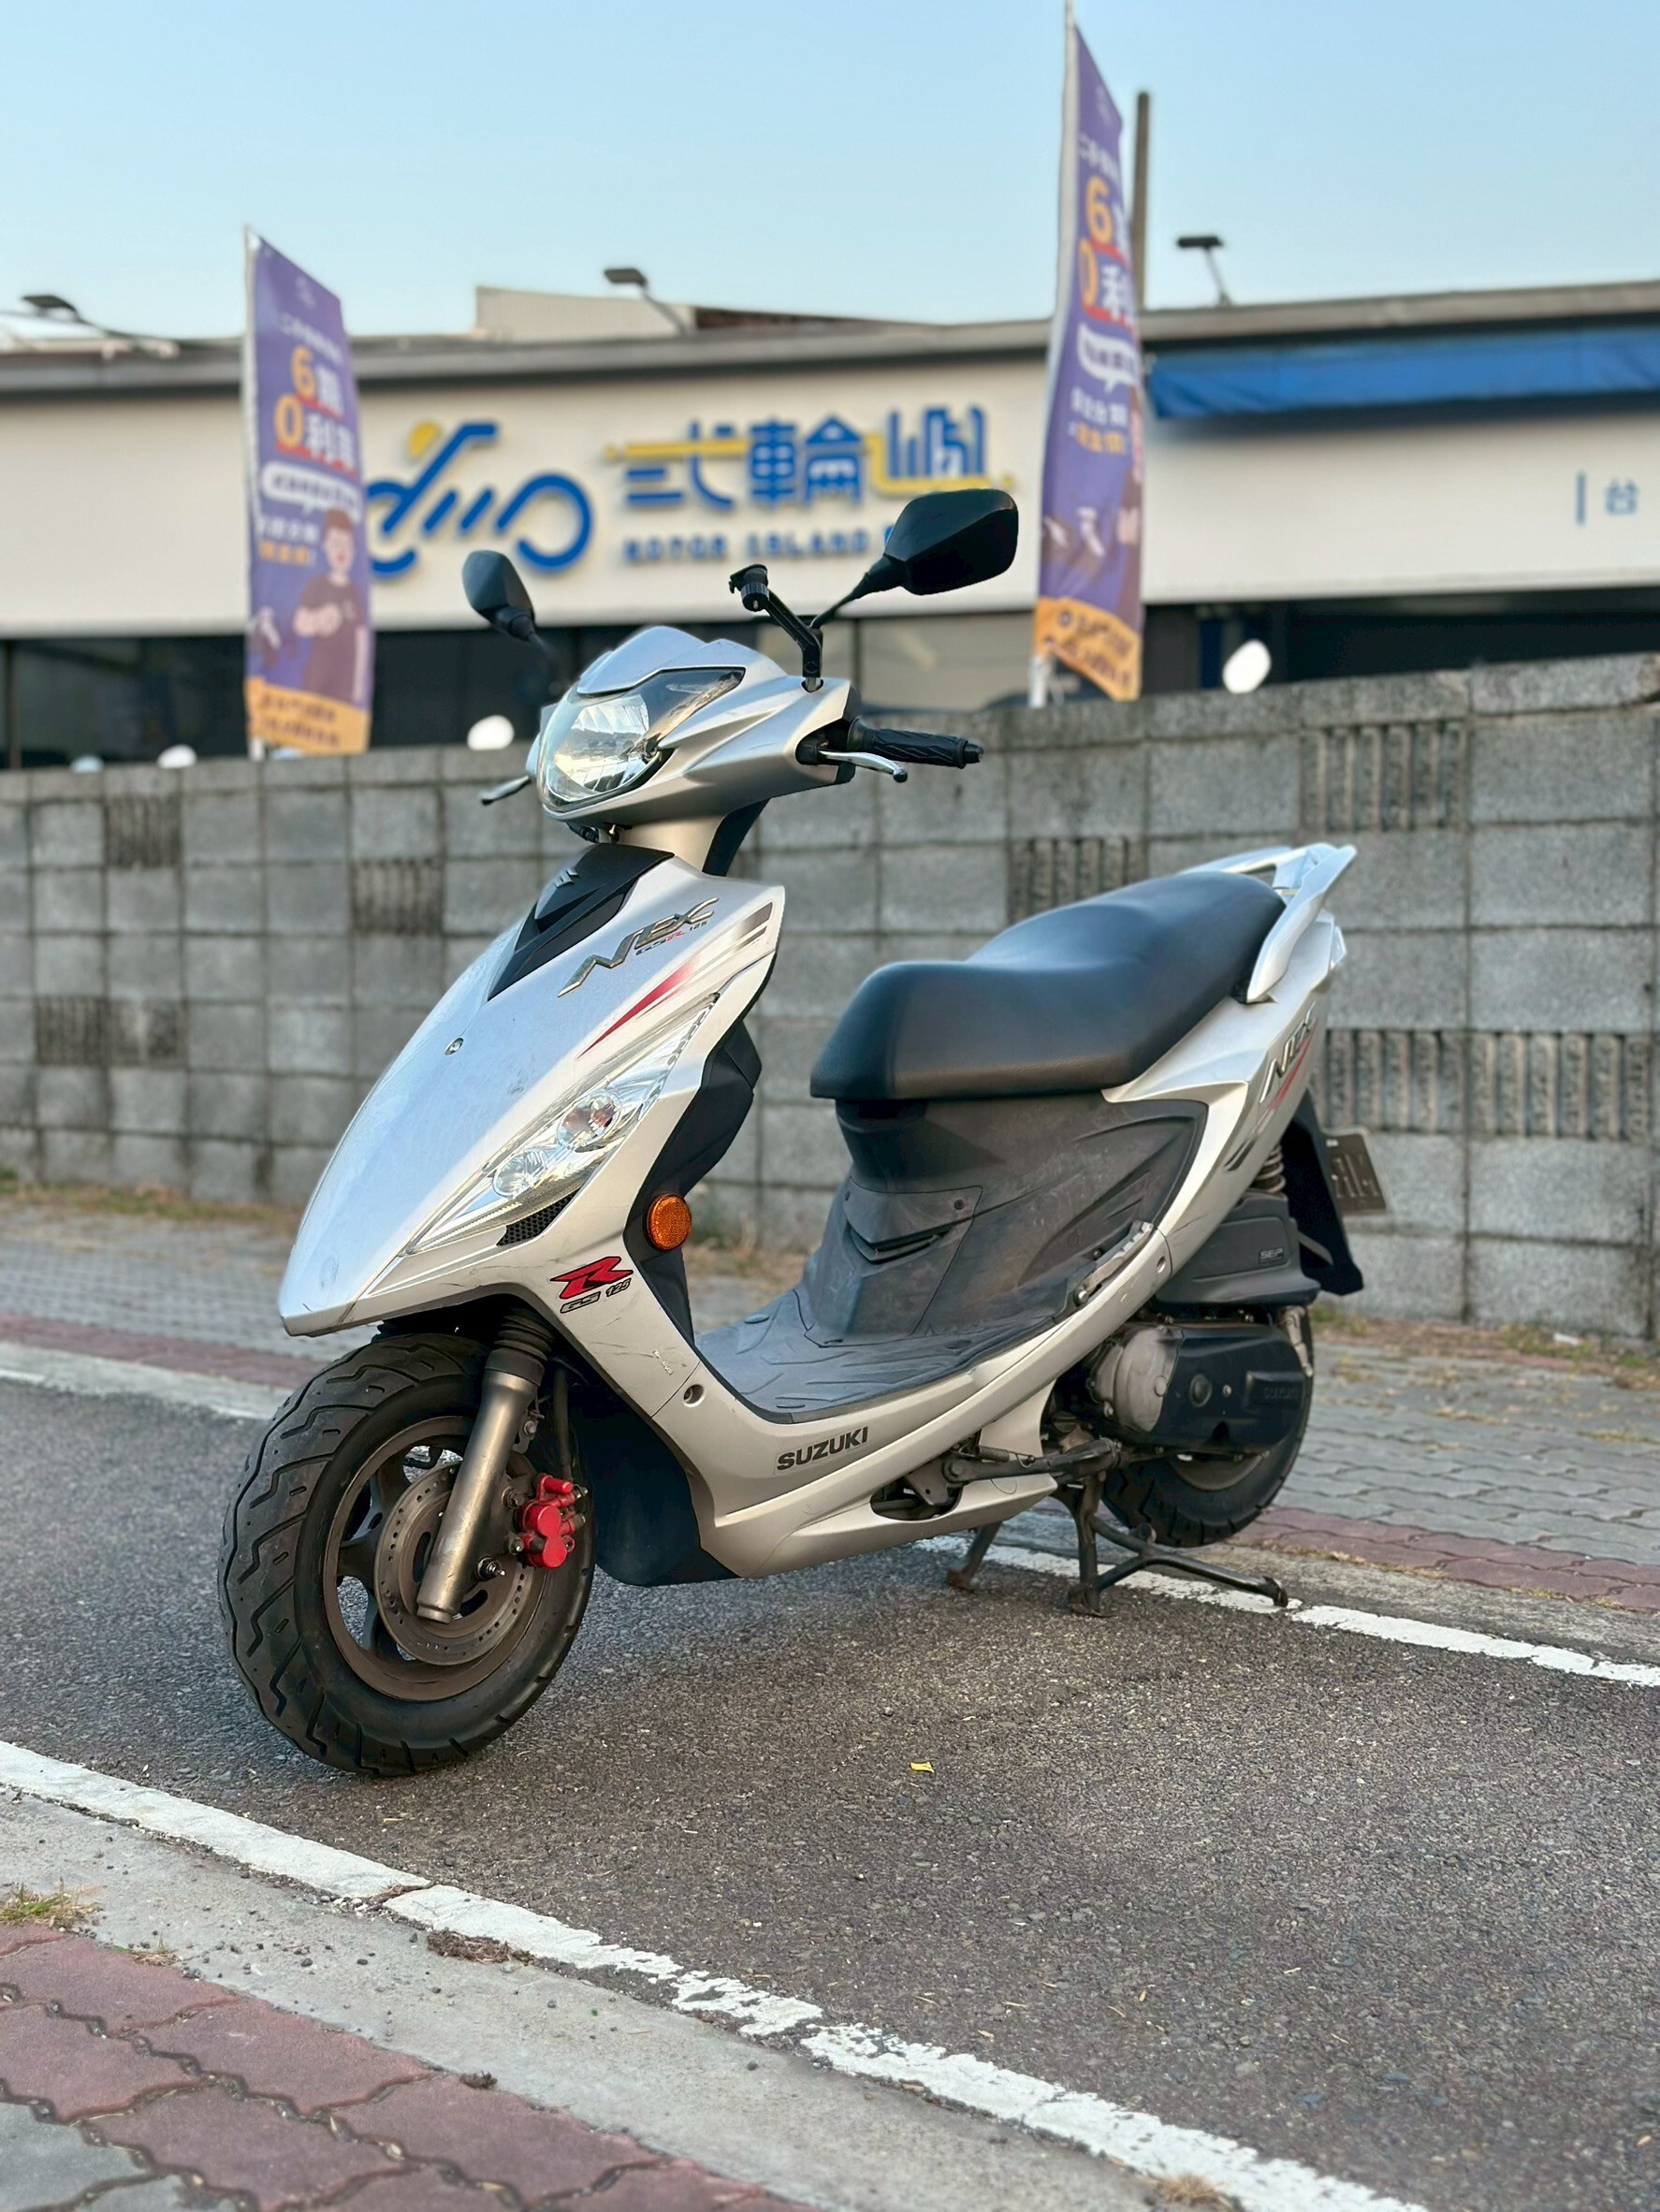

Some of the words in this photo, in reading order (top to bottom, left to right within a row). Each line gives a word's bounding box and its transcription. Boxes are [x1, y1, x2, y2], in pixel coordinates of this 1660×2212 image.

[623, 531, 729, 563] MOTOR
[1260, 1247, 1283, 1259] SEP
[605, 1277, 632, 1298] 125
[777, 1426, 868, 1471] SUZUKI
